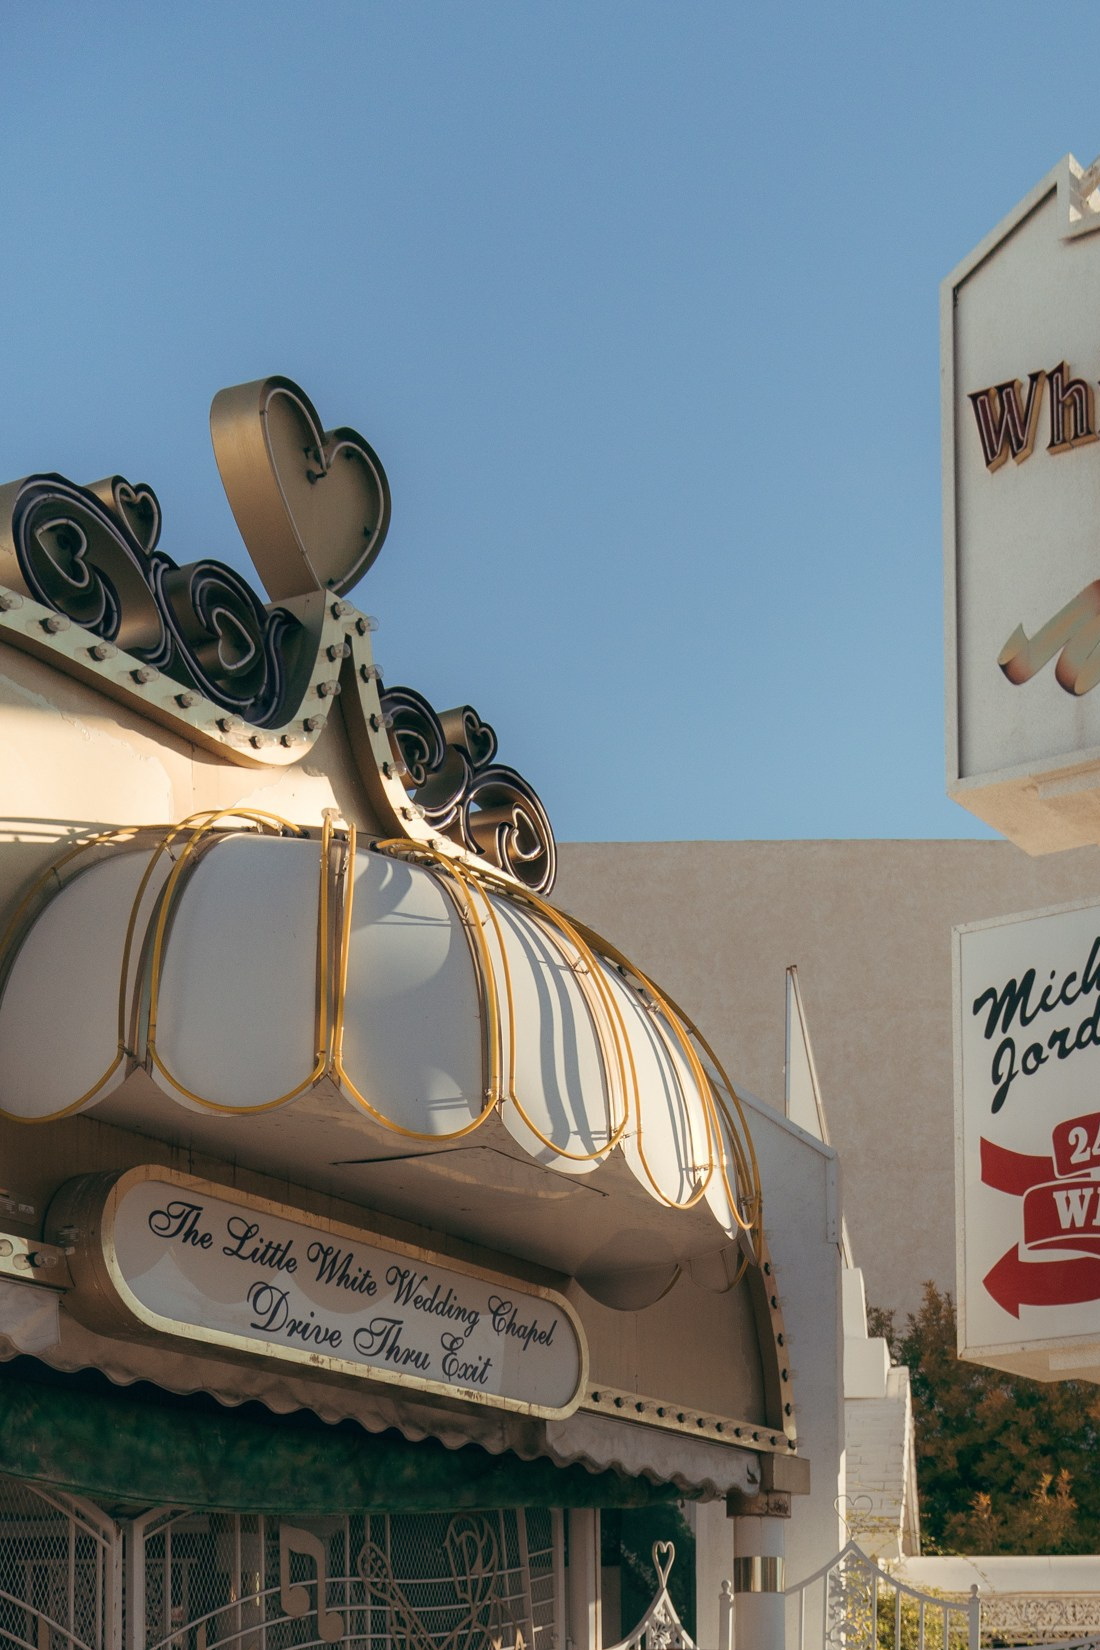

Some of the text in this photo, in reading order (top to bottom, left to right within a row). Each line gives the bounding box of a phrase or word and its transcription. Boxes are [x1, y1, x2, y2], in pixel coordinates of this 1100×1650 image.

[148, 1201, 558, 1352] The Little White Wedding Chapel
[246, 1281, 493, 1385] Drive Thru Exit
